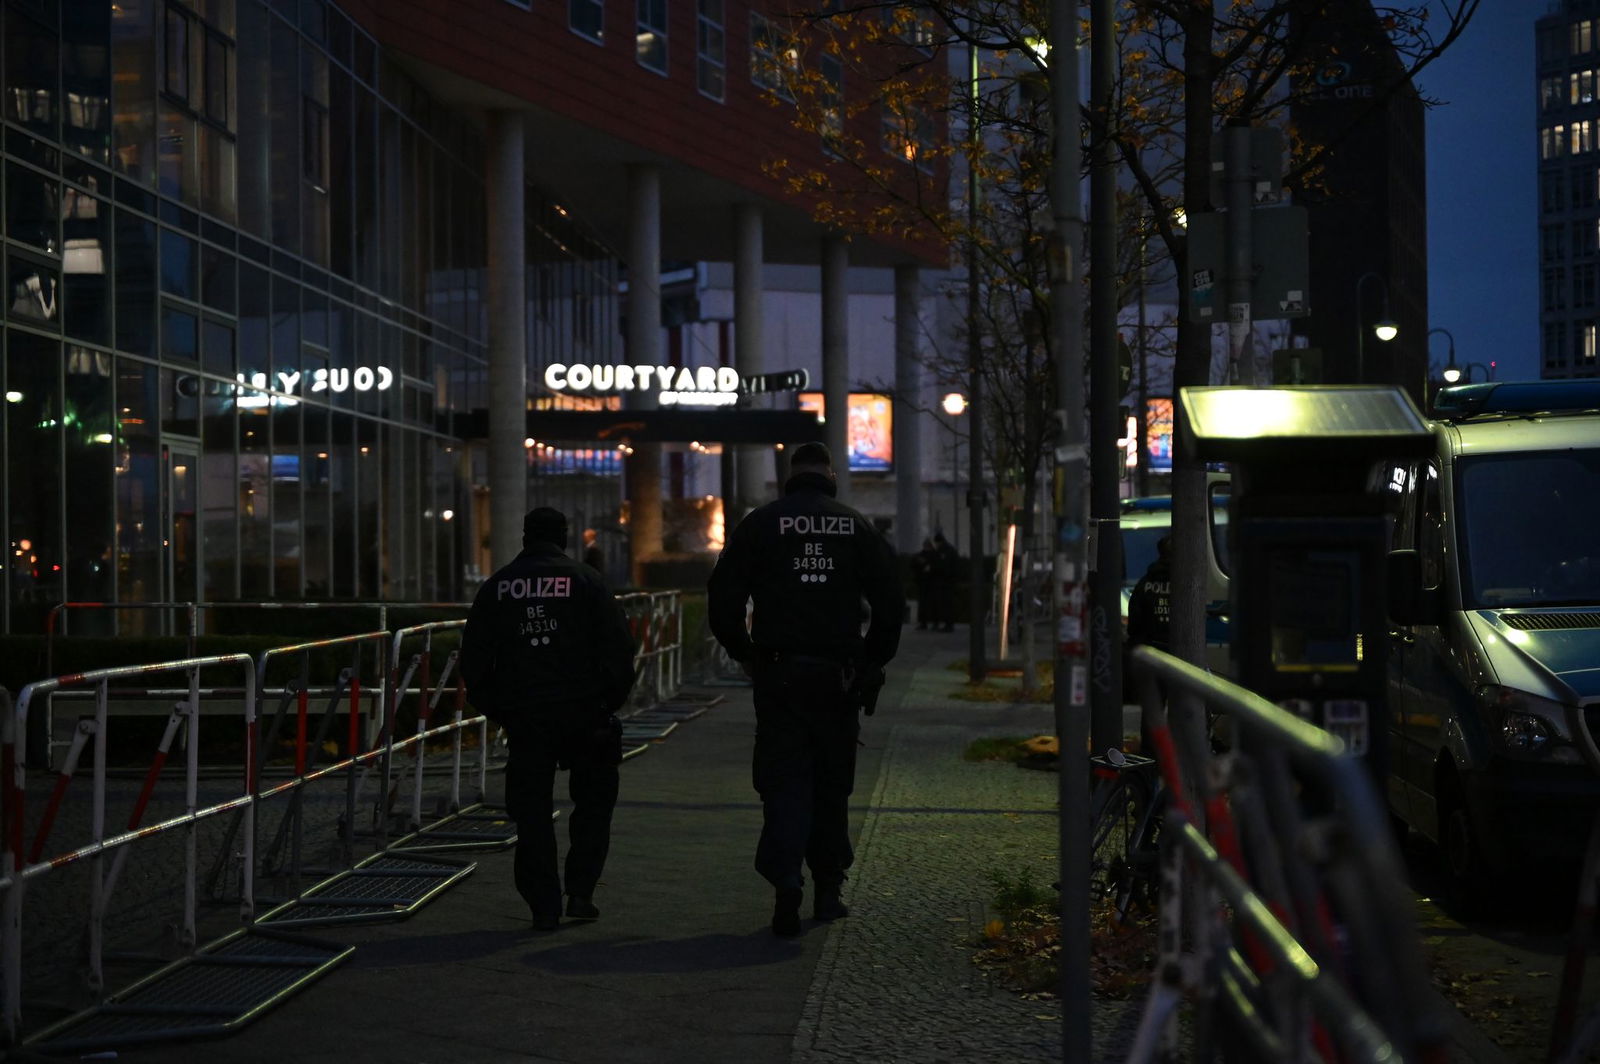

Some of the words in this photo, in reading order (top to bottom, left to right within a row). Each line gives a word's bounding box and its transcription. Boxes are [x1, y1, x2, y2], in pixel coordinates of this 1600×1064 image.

[544, 363, 740, 392] COURTYARD
[779, 515, 855, 535] POLIZEI
[804, 542, 824, 556] BE
[793, 557, 836, 570] 34301
[497, 576, 572, 601] POLIZEI
[526, 604, 545, 620] BE
